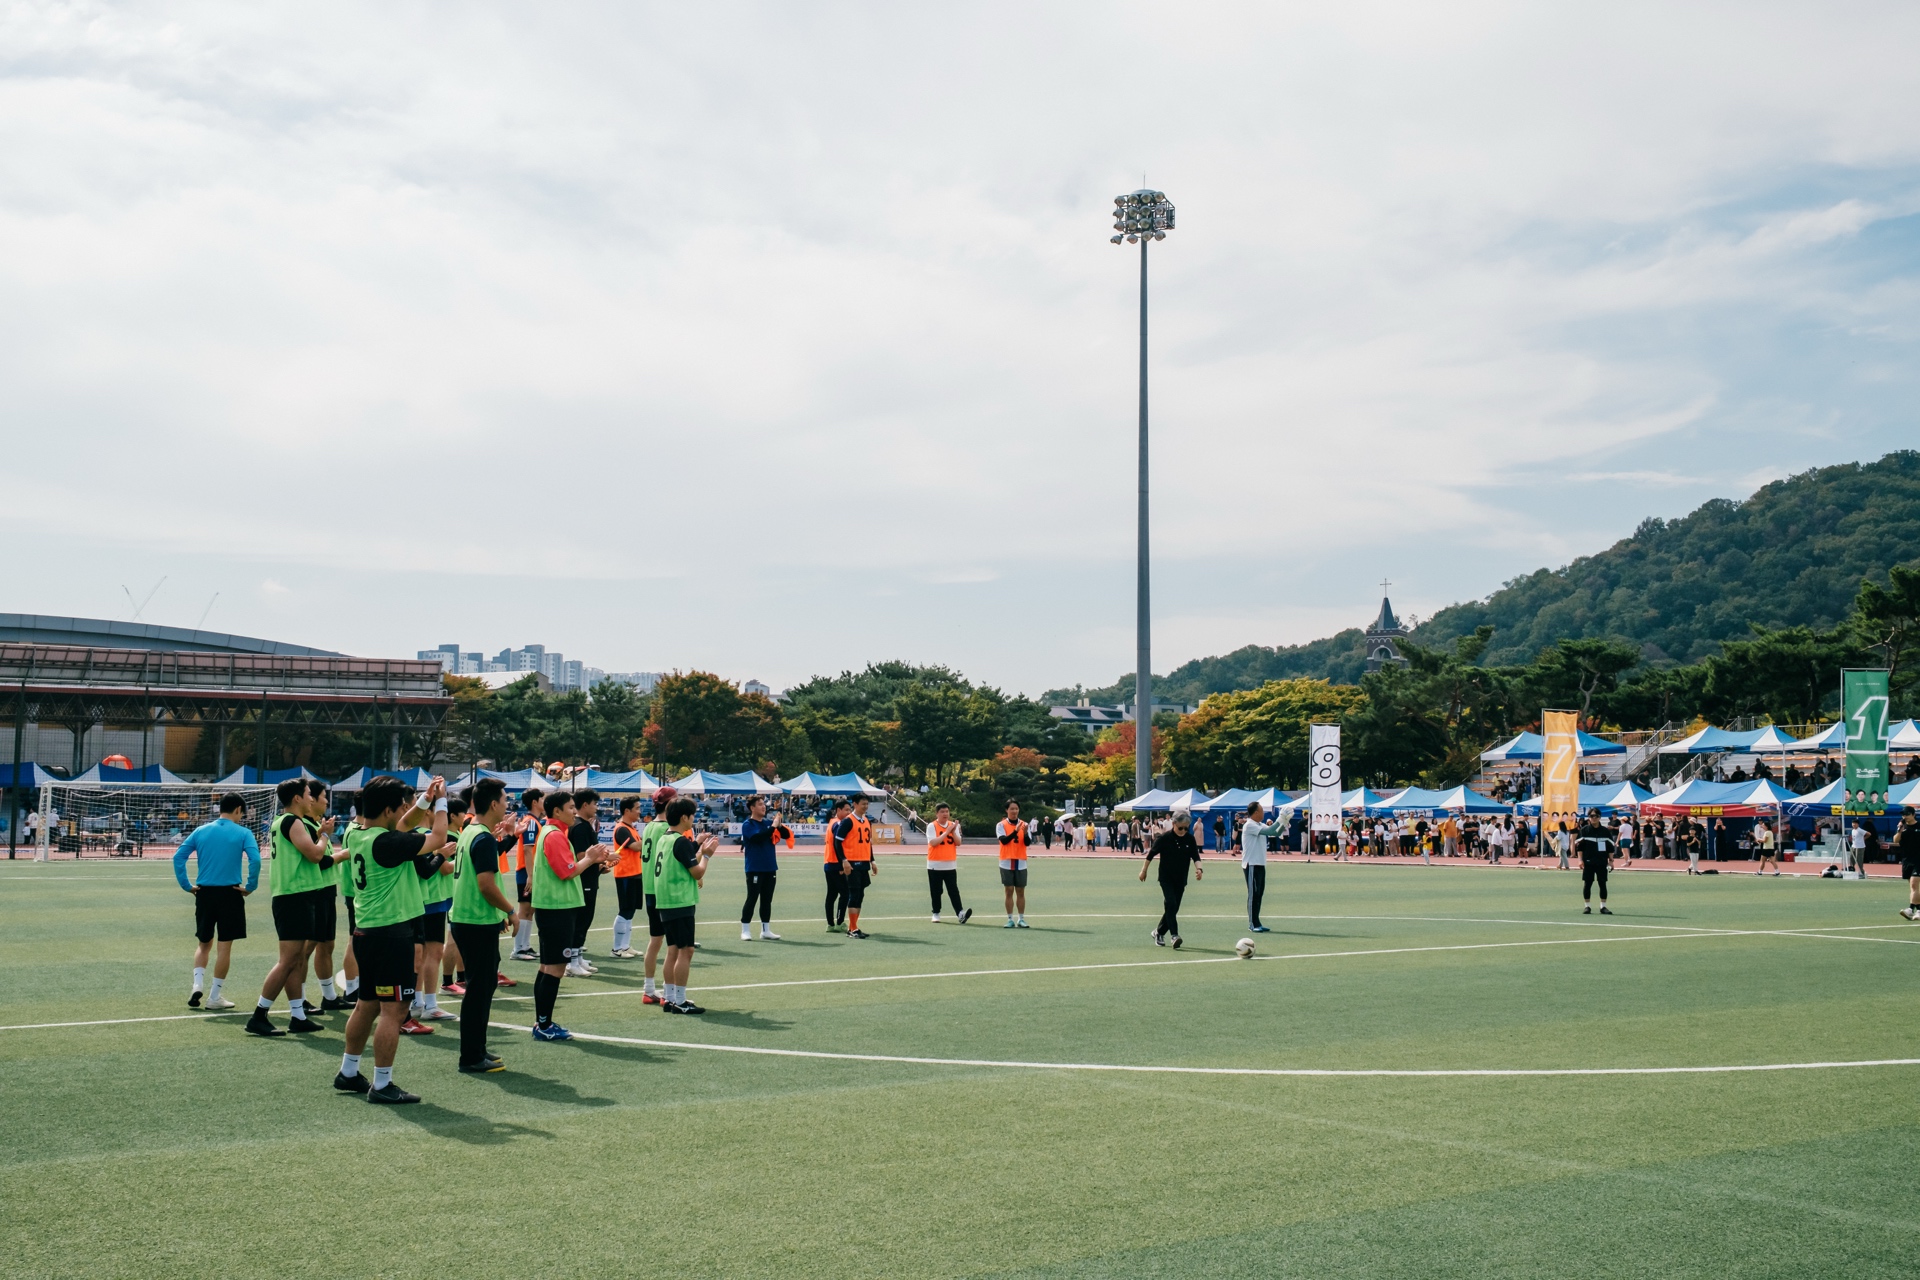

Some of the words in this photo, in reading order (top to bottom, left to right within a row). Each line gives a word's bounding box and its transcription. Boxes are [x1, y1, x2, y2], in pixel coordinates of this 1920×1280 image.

[1845, 696, 1889, 754] 1
[1311, 744, 1341, 788] 8
[1544, 732, 1577, 782] 7
[858, 827, 871, 843] 13
[654, 851, 664, 877] 6
